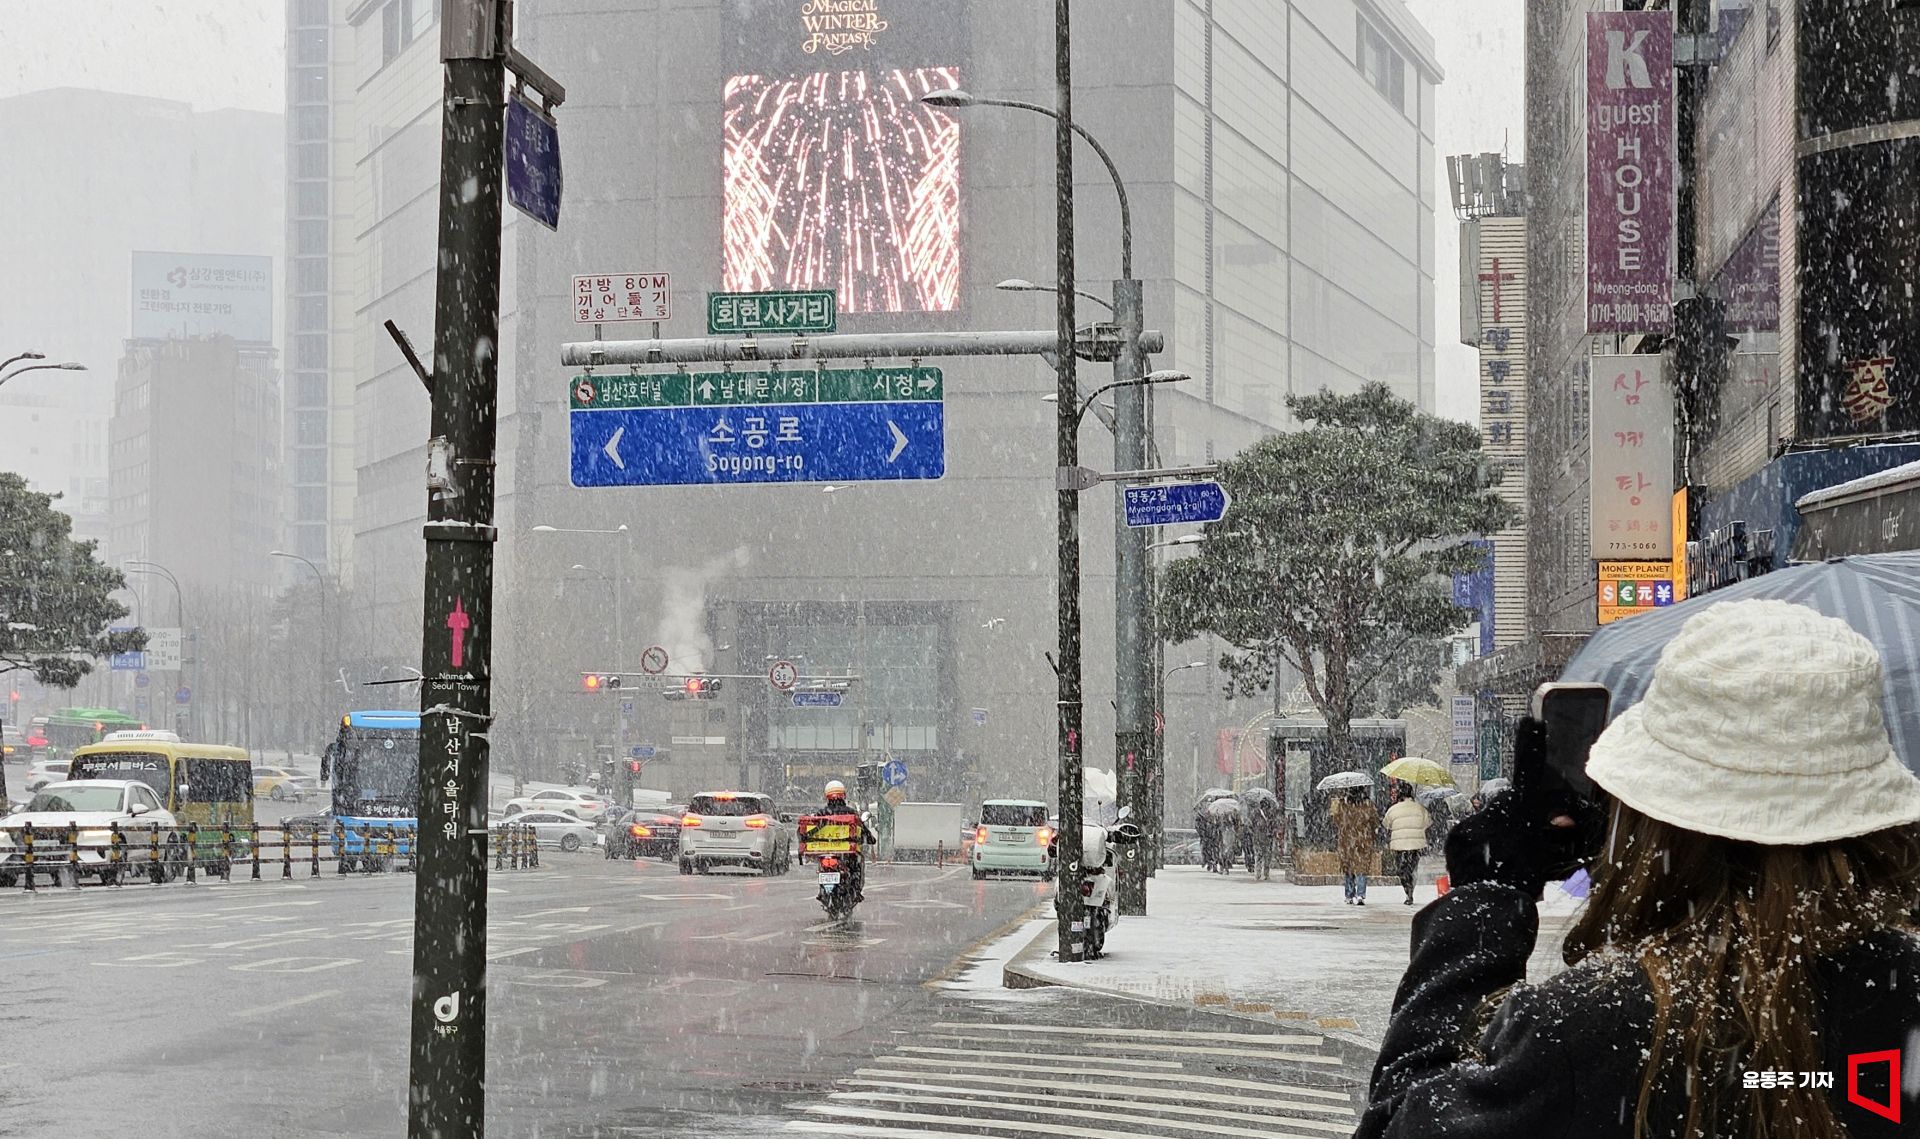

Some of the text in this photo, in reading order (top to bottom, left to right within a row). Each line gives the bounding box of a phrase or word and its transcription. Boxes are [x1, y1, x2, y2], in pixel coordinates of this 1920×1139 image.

[802, 0, 878, 14] MAGICAL
[802, 13, 888, 33] WINTER
[803, 32, 877, 55] FANTASY
[1606, 31, 1653, 89] K
[1600, 101, 1661, 131] guest
[1615, 137, 1642, 270] HOUSE
[578, 276, 666, 292] 전방 80M
[1594, 283, 1658, 295] Myeong-dong
[140, 301, 232, 314] 그린에너지 전문기업
[578, 291, 667, 308] 끼어들기
[579, 307, 605, 320] 영상
[617, 305, 643, 317] 단속
[601, 381, 661, 401] 남산3호터널
[720, 376, 807, 399] 남대문시장
[873, 374, 914, 397] 시청
[708, 416, 803, 449] 소공로
[708, 453, 804, 475] Sogong-ro
[1128, 489, 1168, 504] 명동2길
[1128, 503, 1182, 514] Myeongdong
[1609, 542, 1657, 550] 773-5060
[1602, 564, 1670, 573] MONEY PLANET
[1604, 608, 1616, 616] NO
[432, 681, 480, 691] Seoul Tower
[442, 716, 462, 841] 남산서울타워
